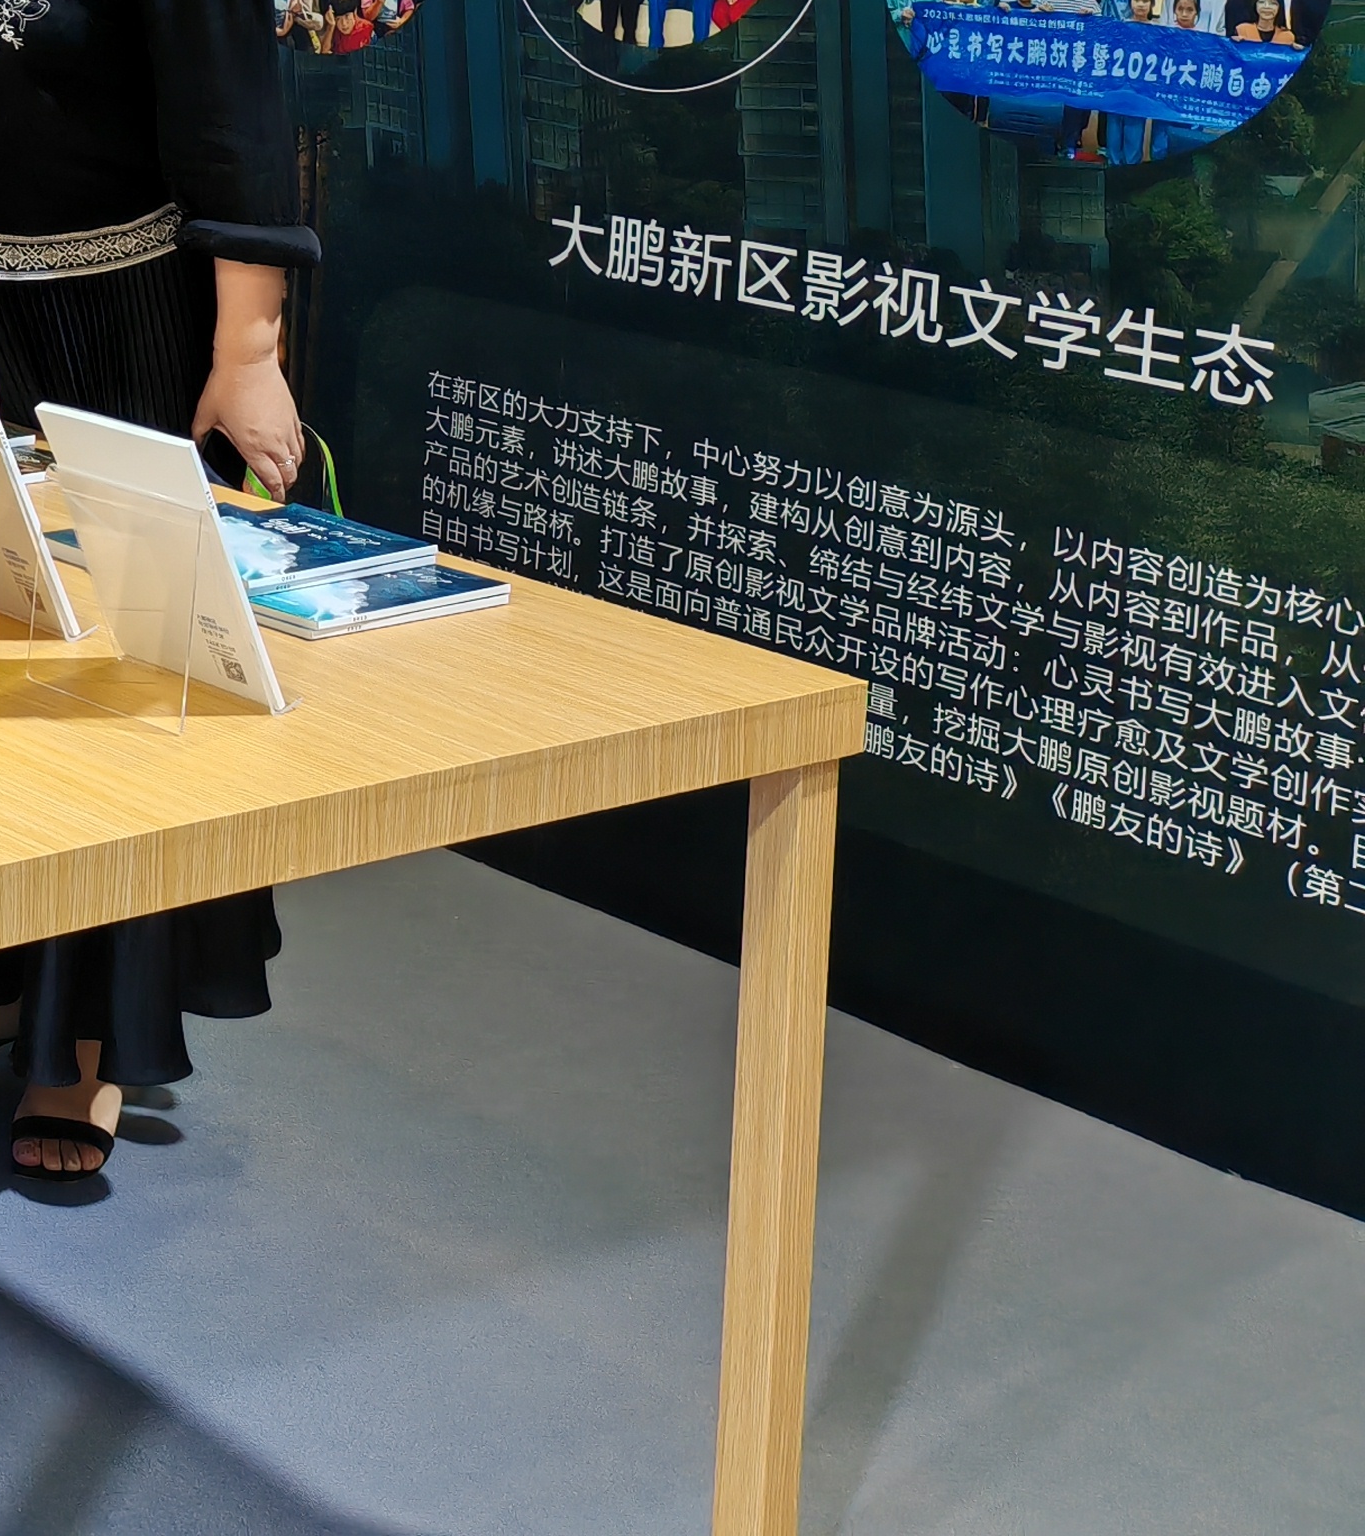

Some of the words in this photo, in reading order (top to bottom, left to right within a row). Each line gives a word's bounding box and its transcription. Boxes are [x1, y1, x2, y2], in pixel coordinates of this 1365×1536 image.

[549, 205, 1275, 406] 大鹏新区影视文学生态
[422, 474, 1365, 771] 的机缘与路桥。打造了原创影视文学品牌活动：心灵书写大鹏故事
[423, 440, 1365, 730] 产品的艺术创造链条，并探索、缔结与经纬文学与影视有效进入文
[426, 409, 1365, 684] 大鹏元素，讲述大鹏故事，建构从创意到内容，从内容到作品，从
